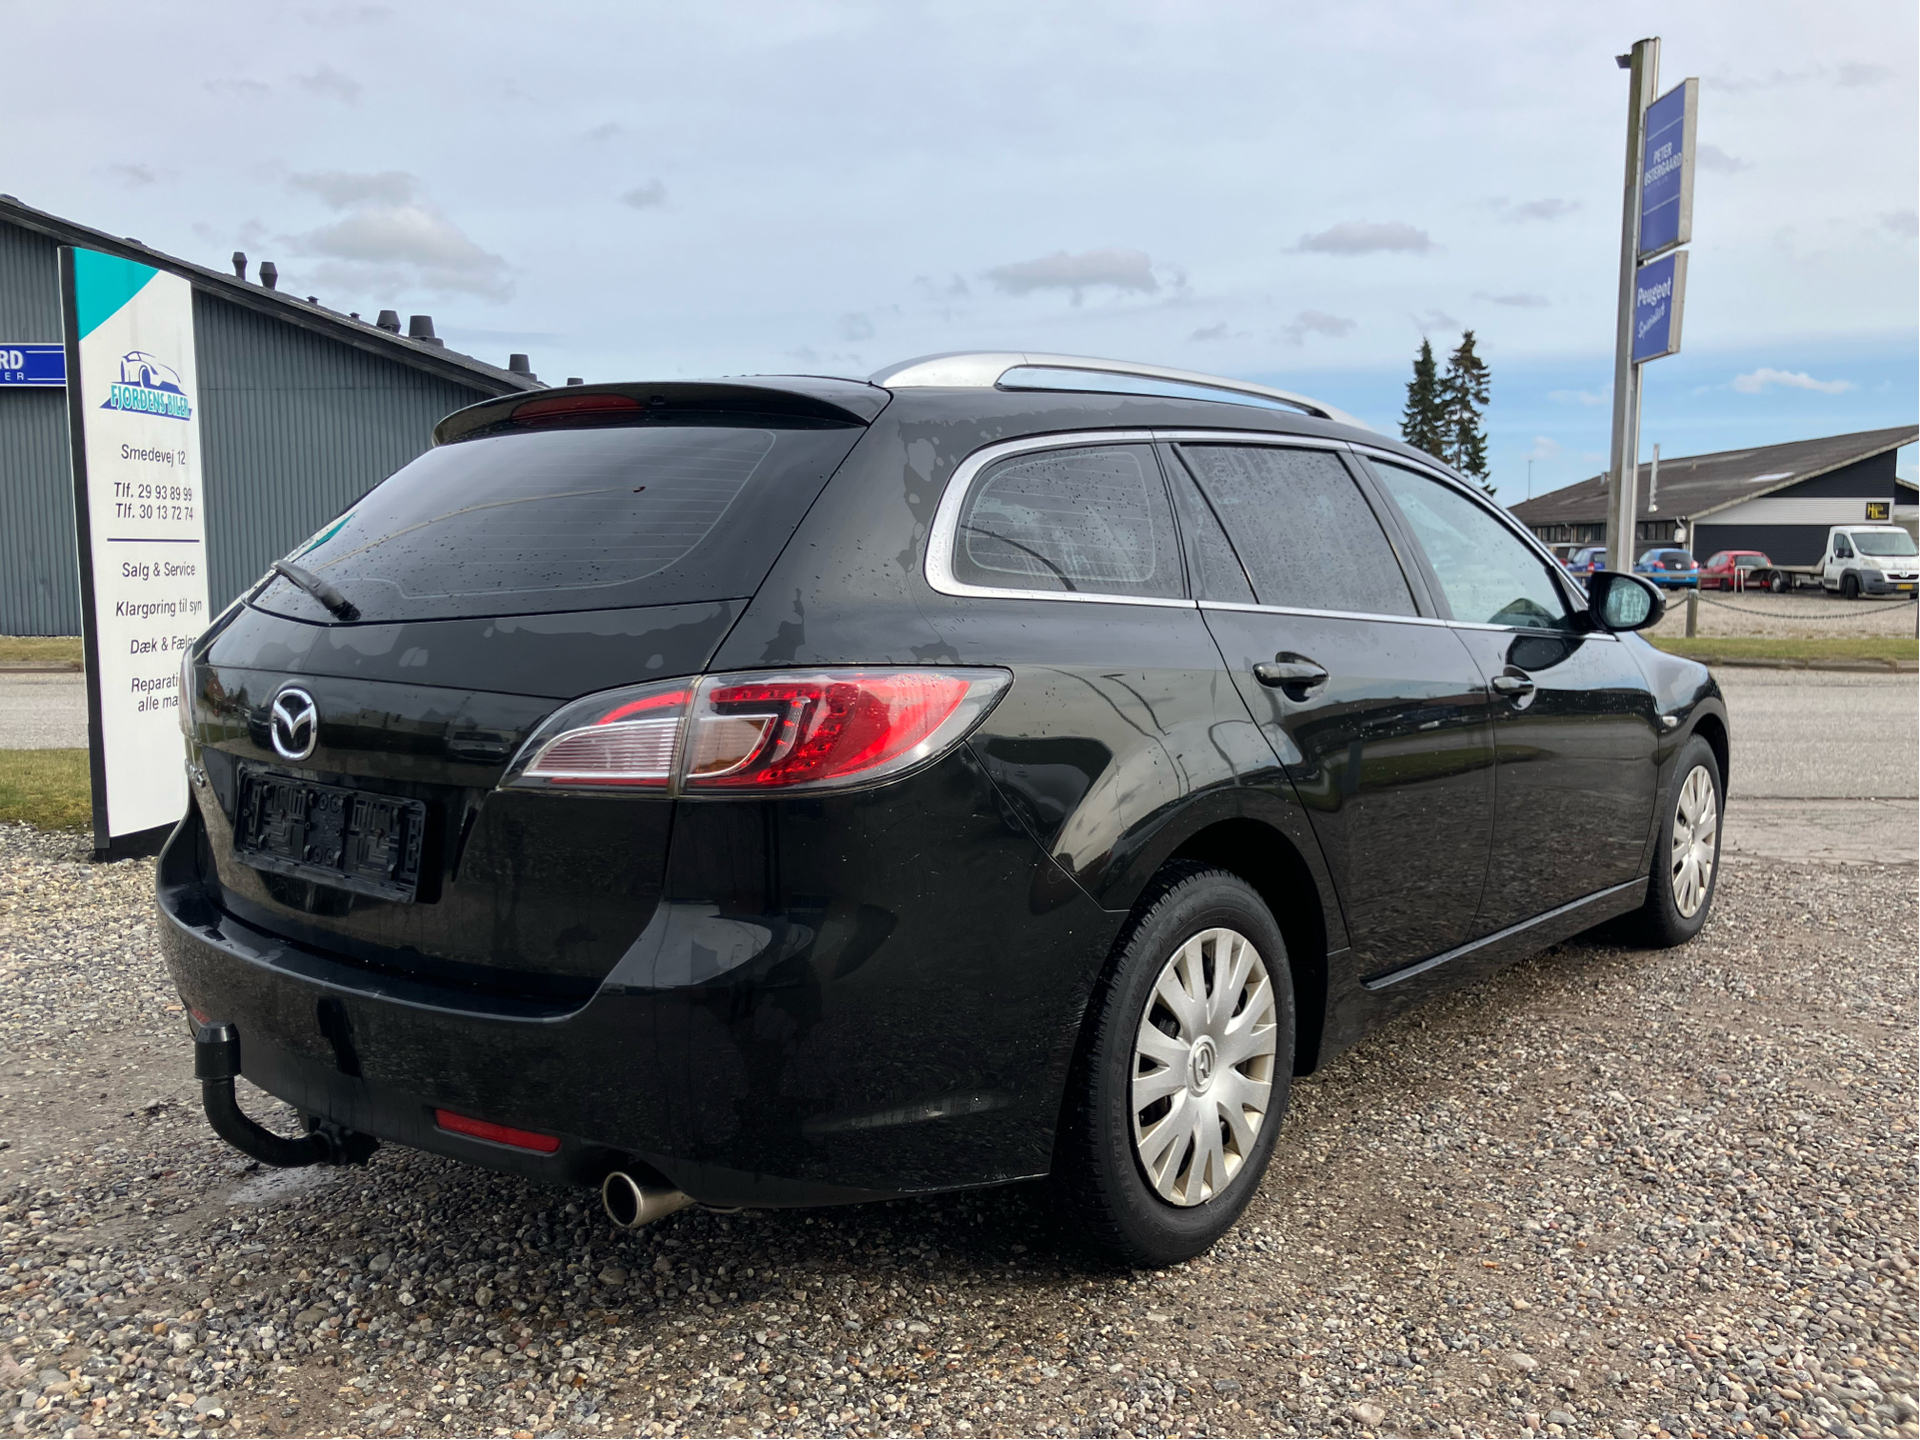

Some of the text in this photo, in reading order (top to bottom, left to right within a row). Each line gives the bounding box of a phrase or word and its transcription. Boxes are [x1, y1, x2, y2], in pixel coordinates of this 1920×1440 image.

[1637, 276, 1671, 307] Peugeot
[0, 349, 24, 370] RD
[110, 384, 190, 418] FJORDENS BILER
[121, 443, 186, 468] Smedevej 12
[114, 482, 193, 502] Tlf. 29 93 89 99
[115, 502, 194, 521] Tlf. 30 13 72 74
[122, 561, 196, 581] Salg & Service
[115, 597, 202, 619] Klargøring til syn
[130, 637, 157, 654] Dæk
[161, 636, 169, 651] &
[131, 672, 179, 695] Reparati
[138, 695, 159, 712] alle
[1111, 1096, 1140, 1211] WINTER
